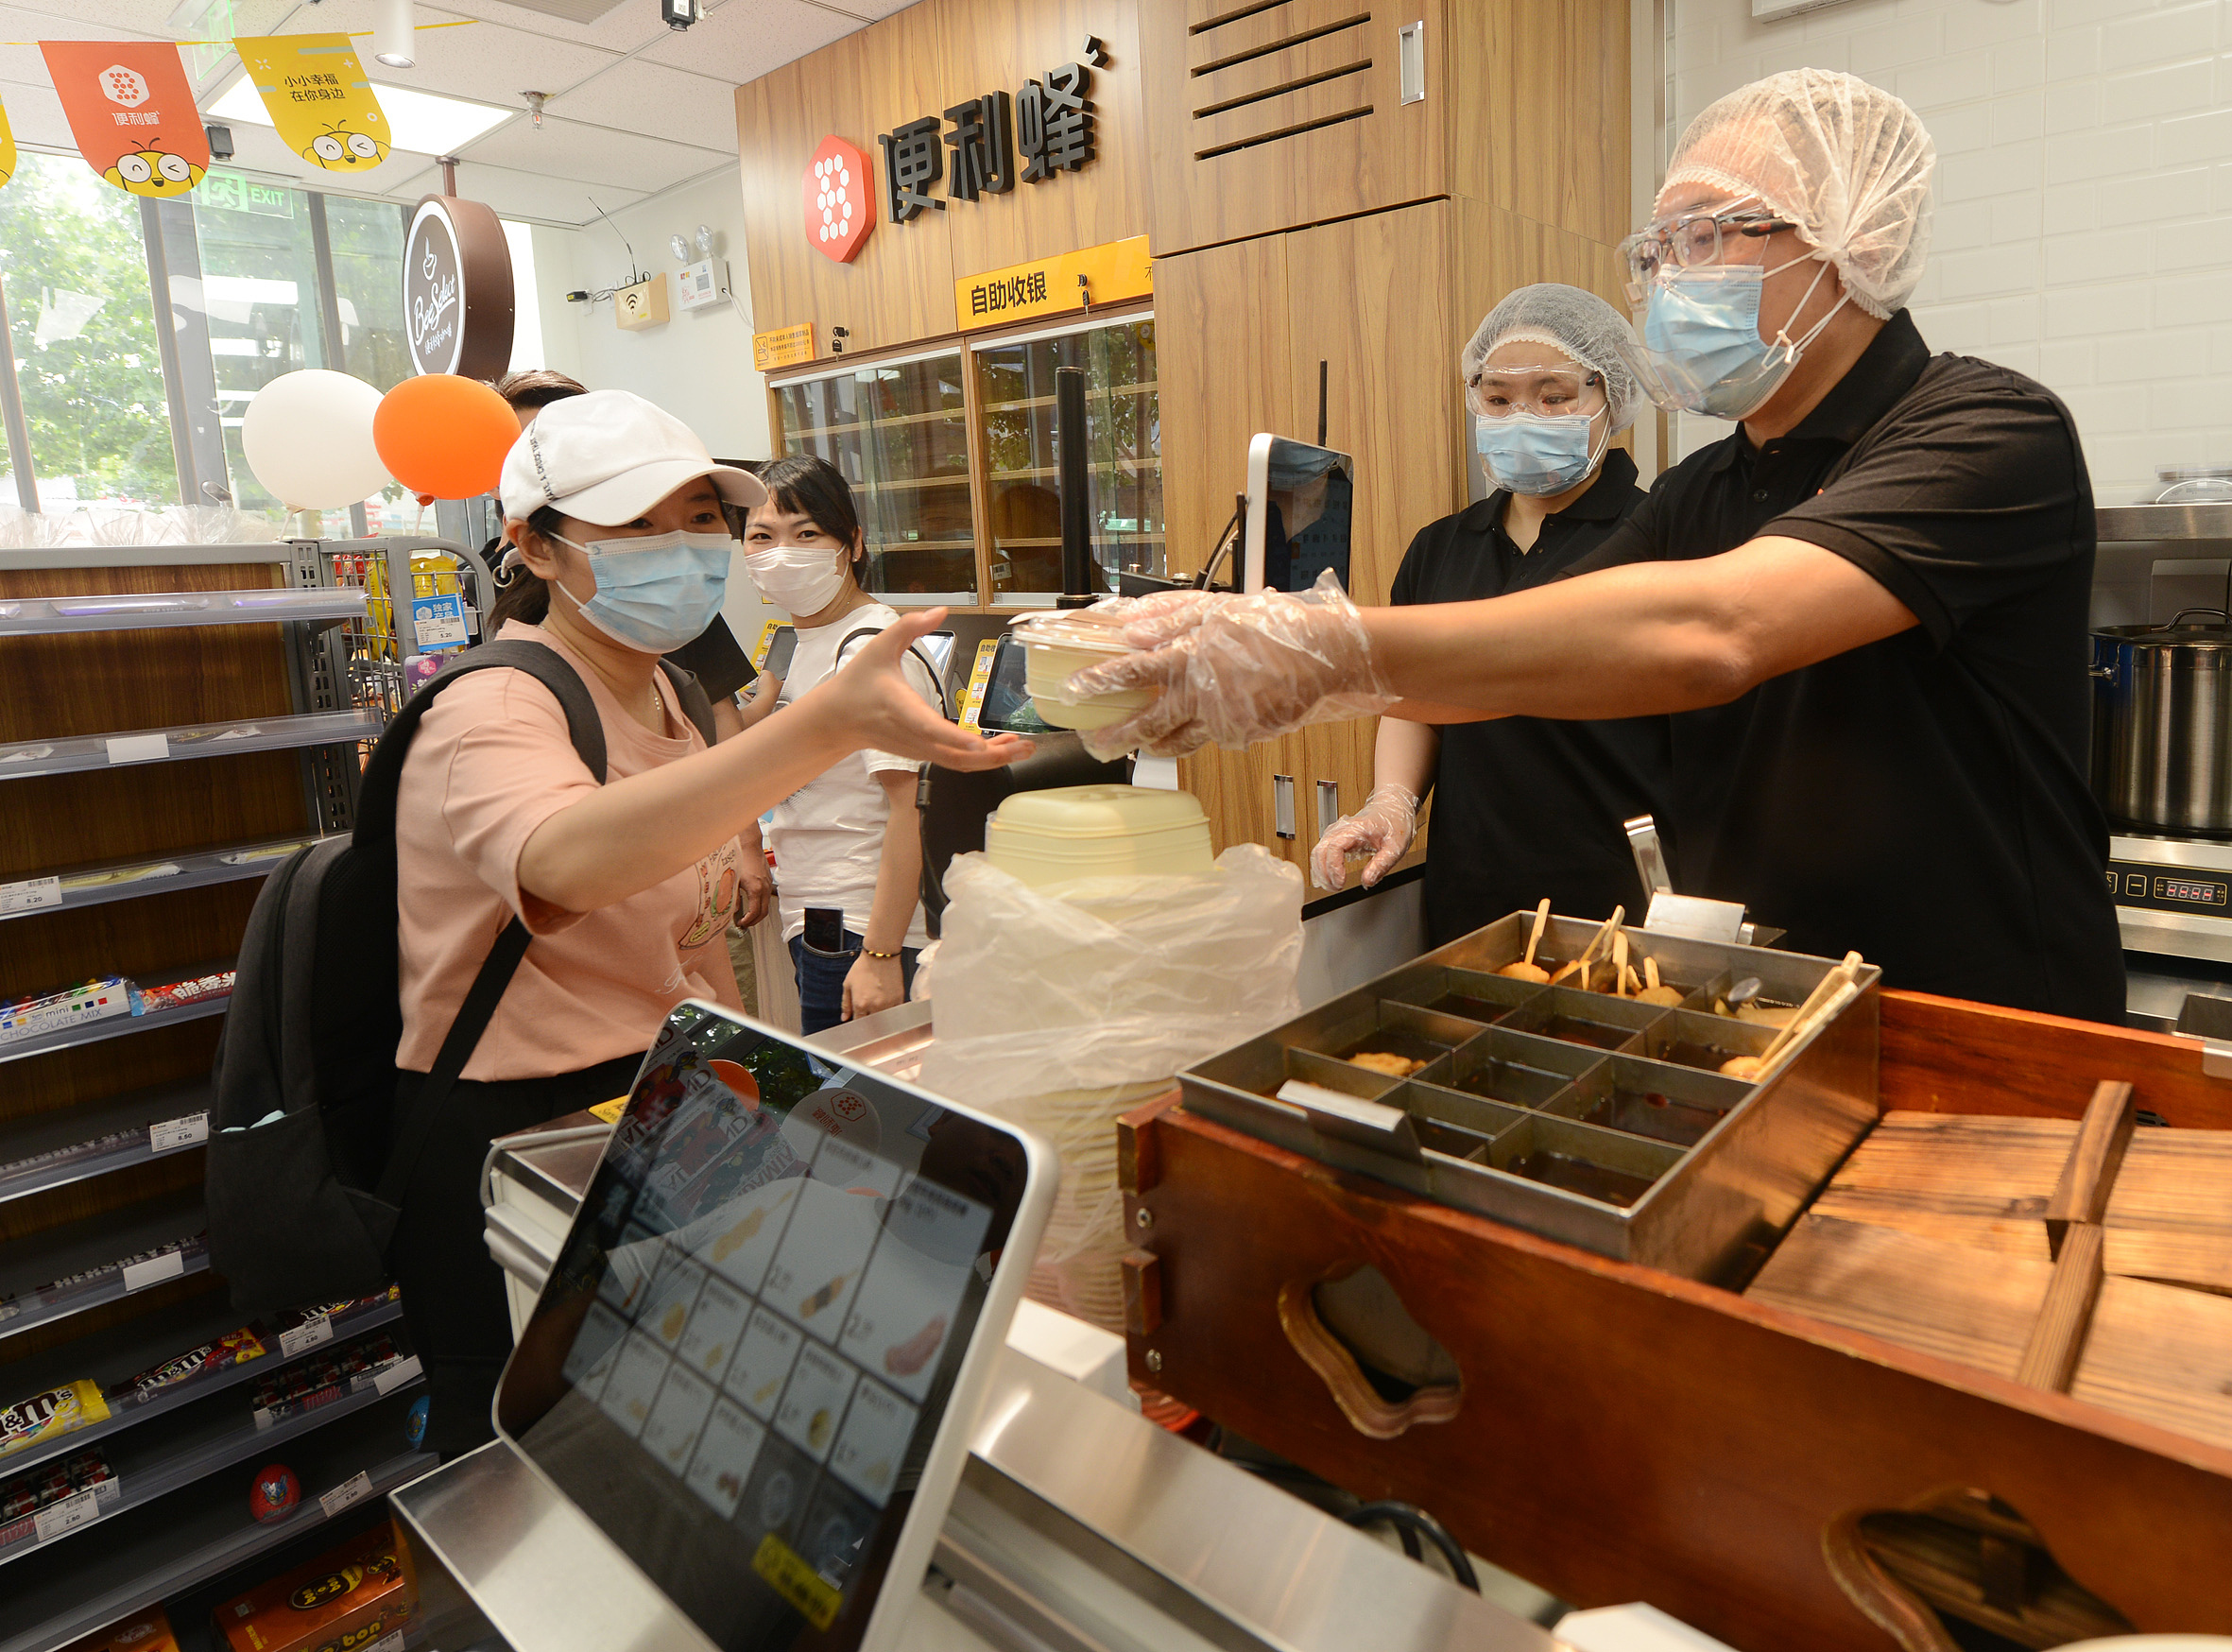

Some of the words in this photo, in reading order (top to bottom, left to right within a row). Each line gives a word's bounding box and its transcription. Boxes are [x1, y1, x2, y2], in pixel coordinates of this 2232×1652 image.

[284, 74, 339, 87] 小小幸福
[290, 88, 346, 102] 在你身边
[112, 111, 160, 126] 便利蜂
[878, 36, 1107, 224] 便利蜂
[250, 187, 284, 206] EXIT
[971, 271, 1048, 317] 自助收银
[433, 602, 454, 612] 独家
[171, 972, 236, 1000] 脆香米
[45, 1006, 69, 1018] mini
[0, 1016, 76, 1040] CHOCOLATE
[80, 1008, 102, 1021] MIX
[342, 1621, 382, 1647] bon
